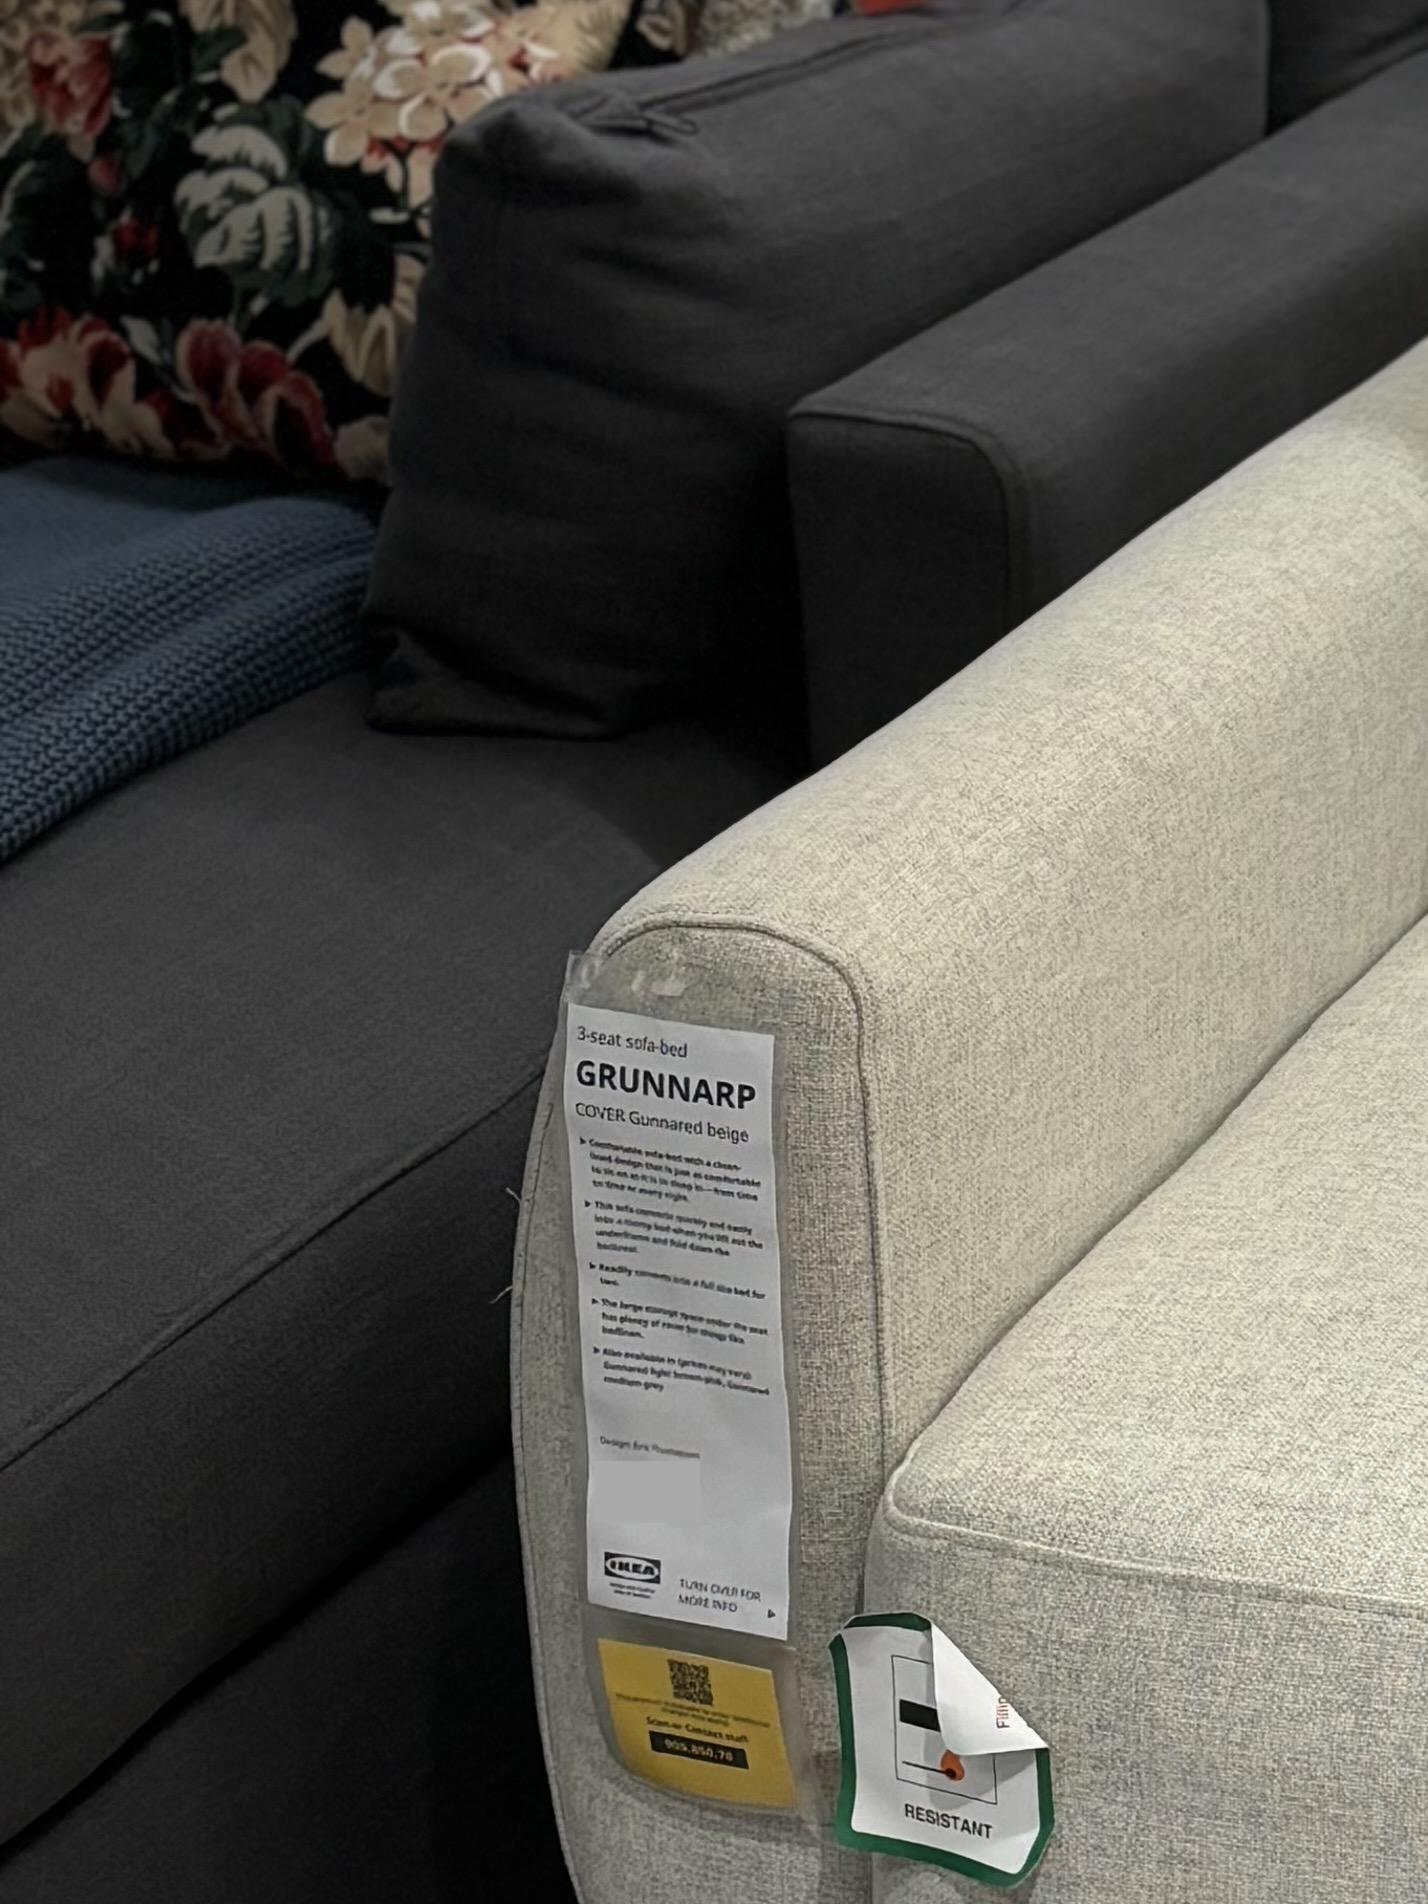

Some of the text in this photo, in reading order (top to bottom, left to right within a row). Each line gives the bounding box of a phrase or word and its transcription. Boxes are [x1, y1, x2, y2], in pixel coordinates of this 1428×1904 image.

[577, 1026, 687, 1058] 3-seat sofa-bed
[576, 1061, 756, 1109] GRUNNARP
[575, 1102, 748, 1144] COVER Gunnared beige
[609, 1559, 655, 1576] IKEA
[678, 1592, 737, 1613] MORE INFO
[679, 1577, 761, 1602] TURN OVER FOR
[904, 1803, 993, 1839] RESISTANT
